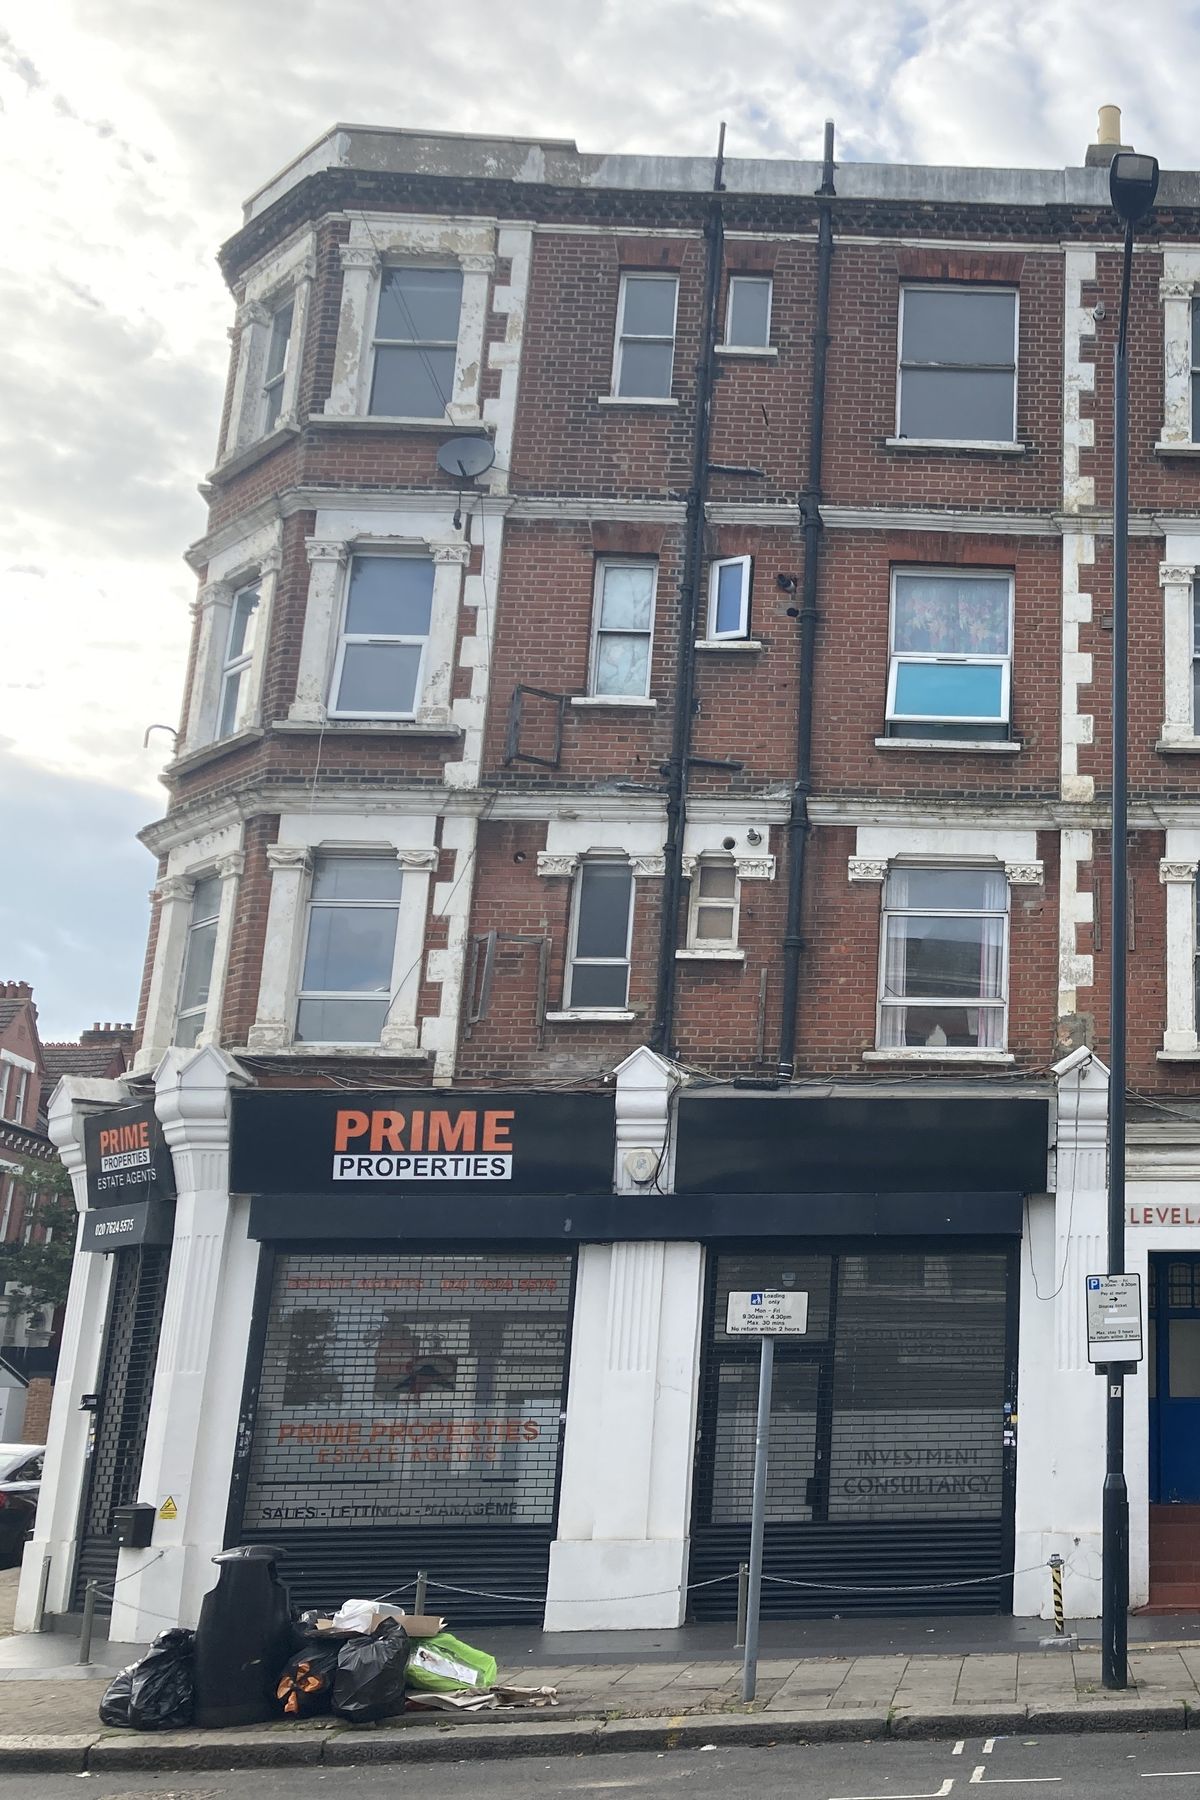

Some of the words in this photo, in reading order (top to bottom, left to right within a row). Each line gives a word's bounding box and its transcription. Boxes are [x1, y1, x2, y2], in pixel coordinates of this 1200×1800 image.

[100, 1121, 149, 1155] PRIME
[334, 1110, 515, 1152] PRIME
[104, 1151, 148, 1170] PROPERTIES
[339, 1157, 506, 1177] PROPERTIES
[98, 1174, 125, 1190] ESTATE
[126, 1168, 157, 1184] AGENTS
[277, 1422, 363, 1446] PRIME
[369, 1420, 542, 1444] PROPERTIES
[318, 1447, 399, 1464] ESTATE
[410, 1446, 497, 1462] AGENTS
[857, 1450, 979, 1466] INVESTMENT
[843, 1475, 993, 1495] CONSULTANCY
[262, 1506, 317, 1520] SALES
